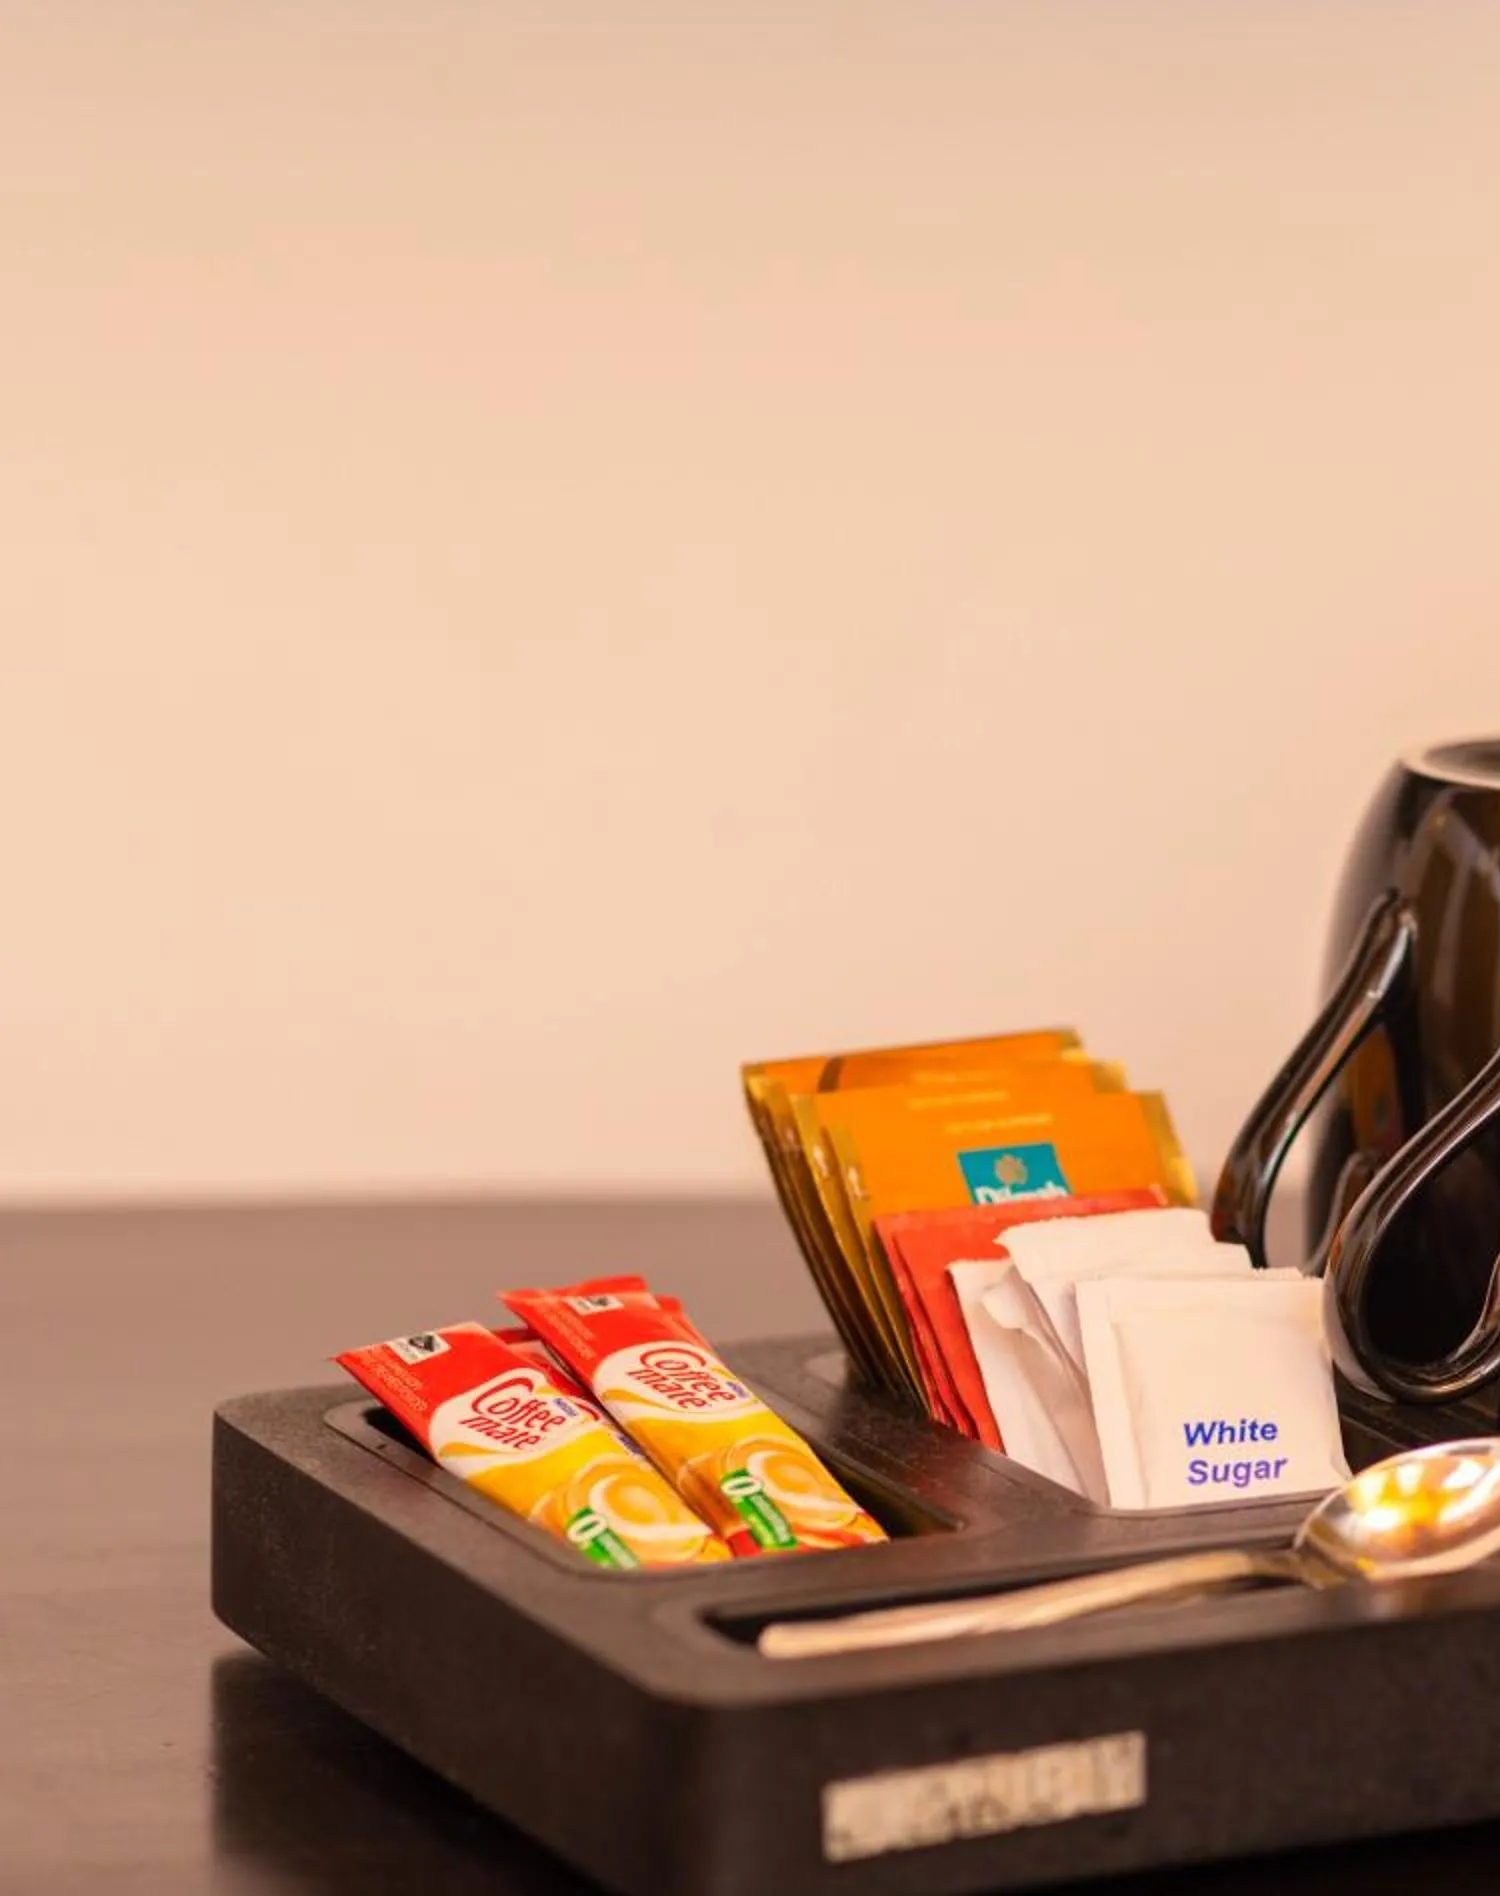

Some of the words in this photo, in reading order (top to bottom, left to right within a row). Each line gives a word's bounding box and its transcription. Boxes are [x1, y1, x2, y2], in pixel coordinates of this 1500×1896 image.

[625, 1368, 708, 1409] mate
[639, 1346, 737, 1402] Coffee
[471, 1376, 567, 1433] Coffee
[458, 1414, 542, 1450] mate
[1183, 1418, 1278, 1447] White
[1187, 1457, 1289, 1488] Sugar
